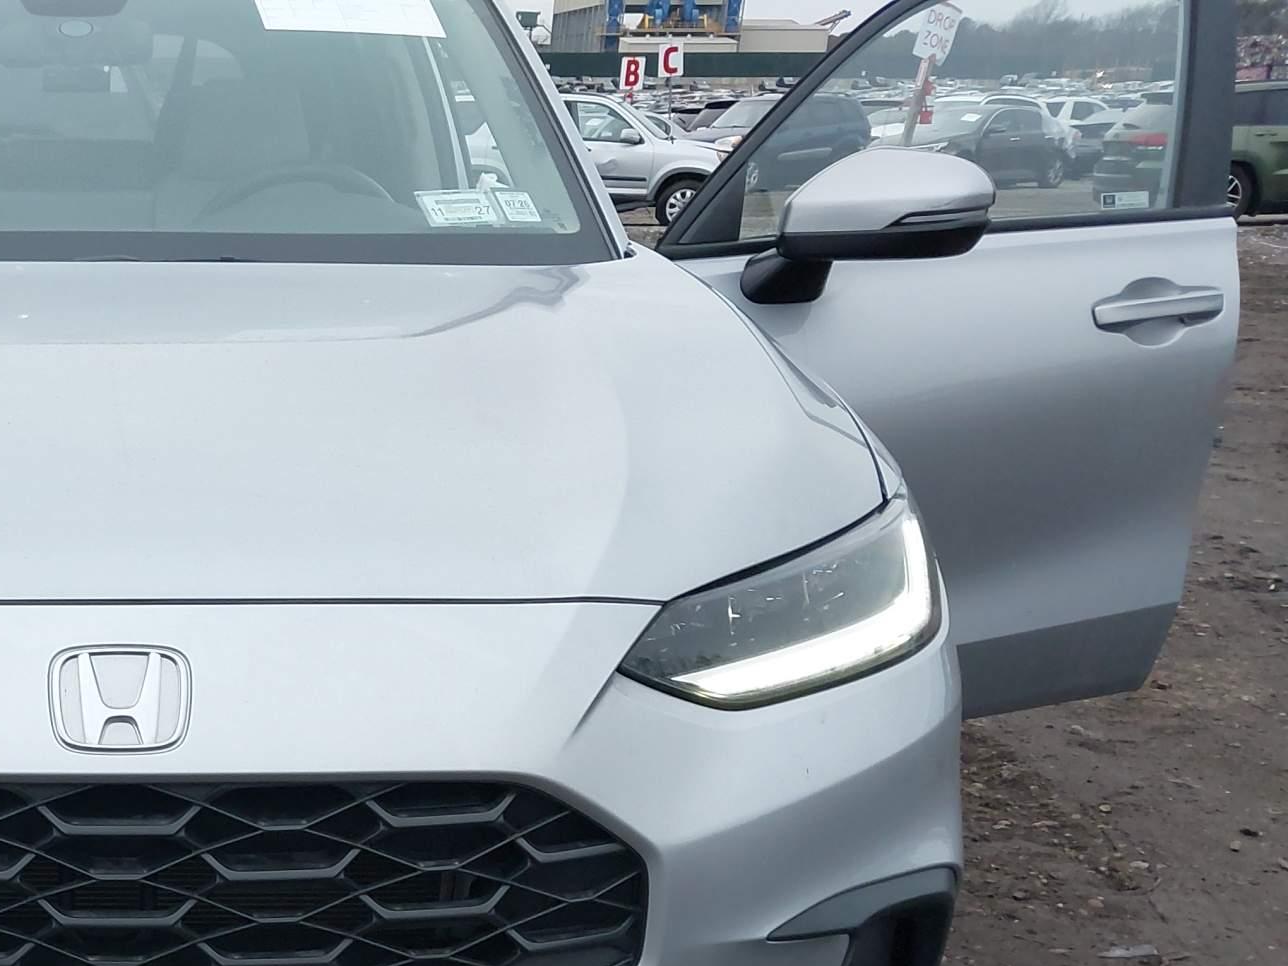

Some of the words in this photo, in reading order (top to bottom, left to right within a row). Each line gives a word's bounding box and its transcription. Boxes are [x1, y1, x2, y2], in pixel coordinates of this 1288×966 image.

[922, 30, 950, 55] ZONE
[624, 59, 640, 87] B
[663, 46, 678, 74] C
[474, 205, 490, 215] 27
